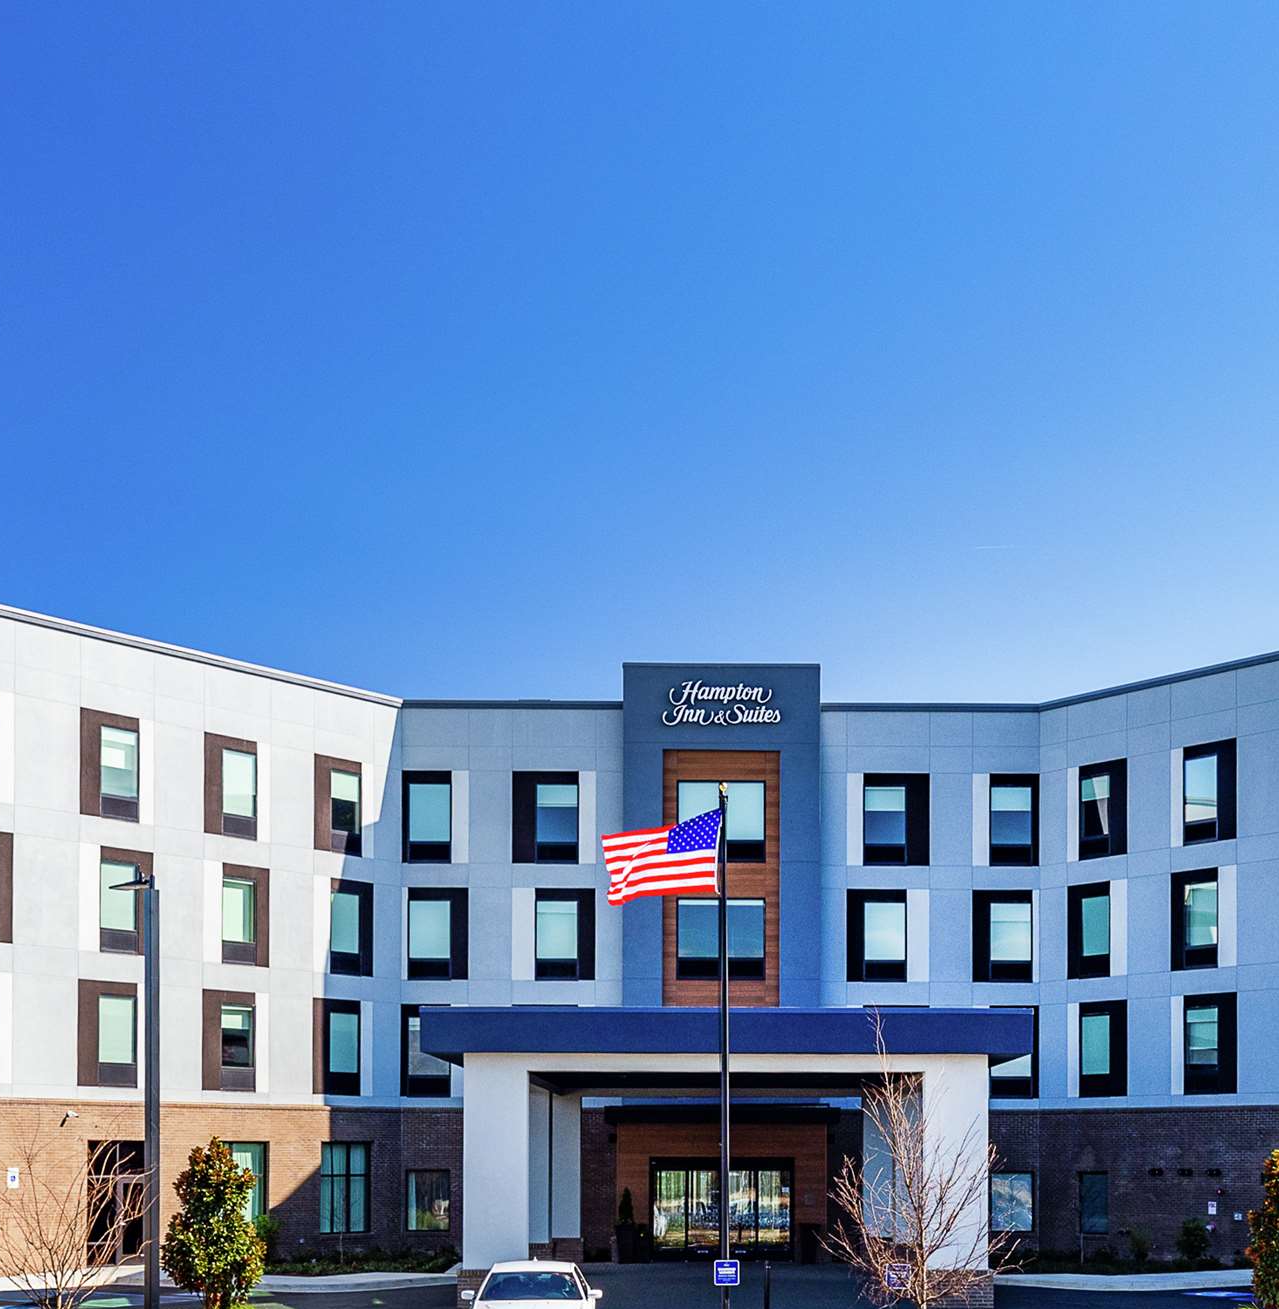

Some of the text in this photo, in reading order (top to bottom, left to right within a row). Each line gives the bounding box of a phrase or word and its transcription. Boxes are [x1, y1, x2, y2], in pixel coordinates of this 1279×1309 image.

[669, 680, 772, 706] Hampton
[662, 704, 781, 726] Inn & Suites
